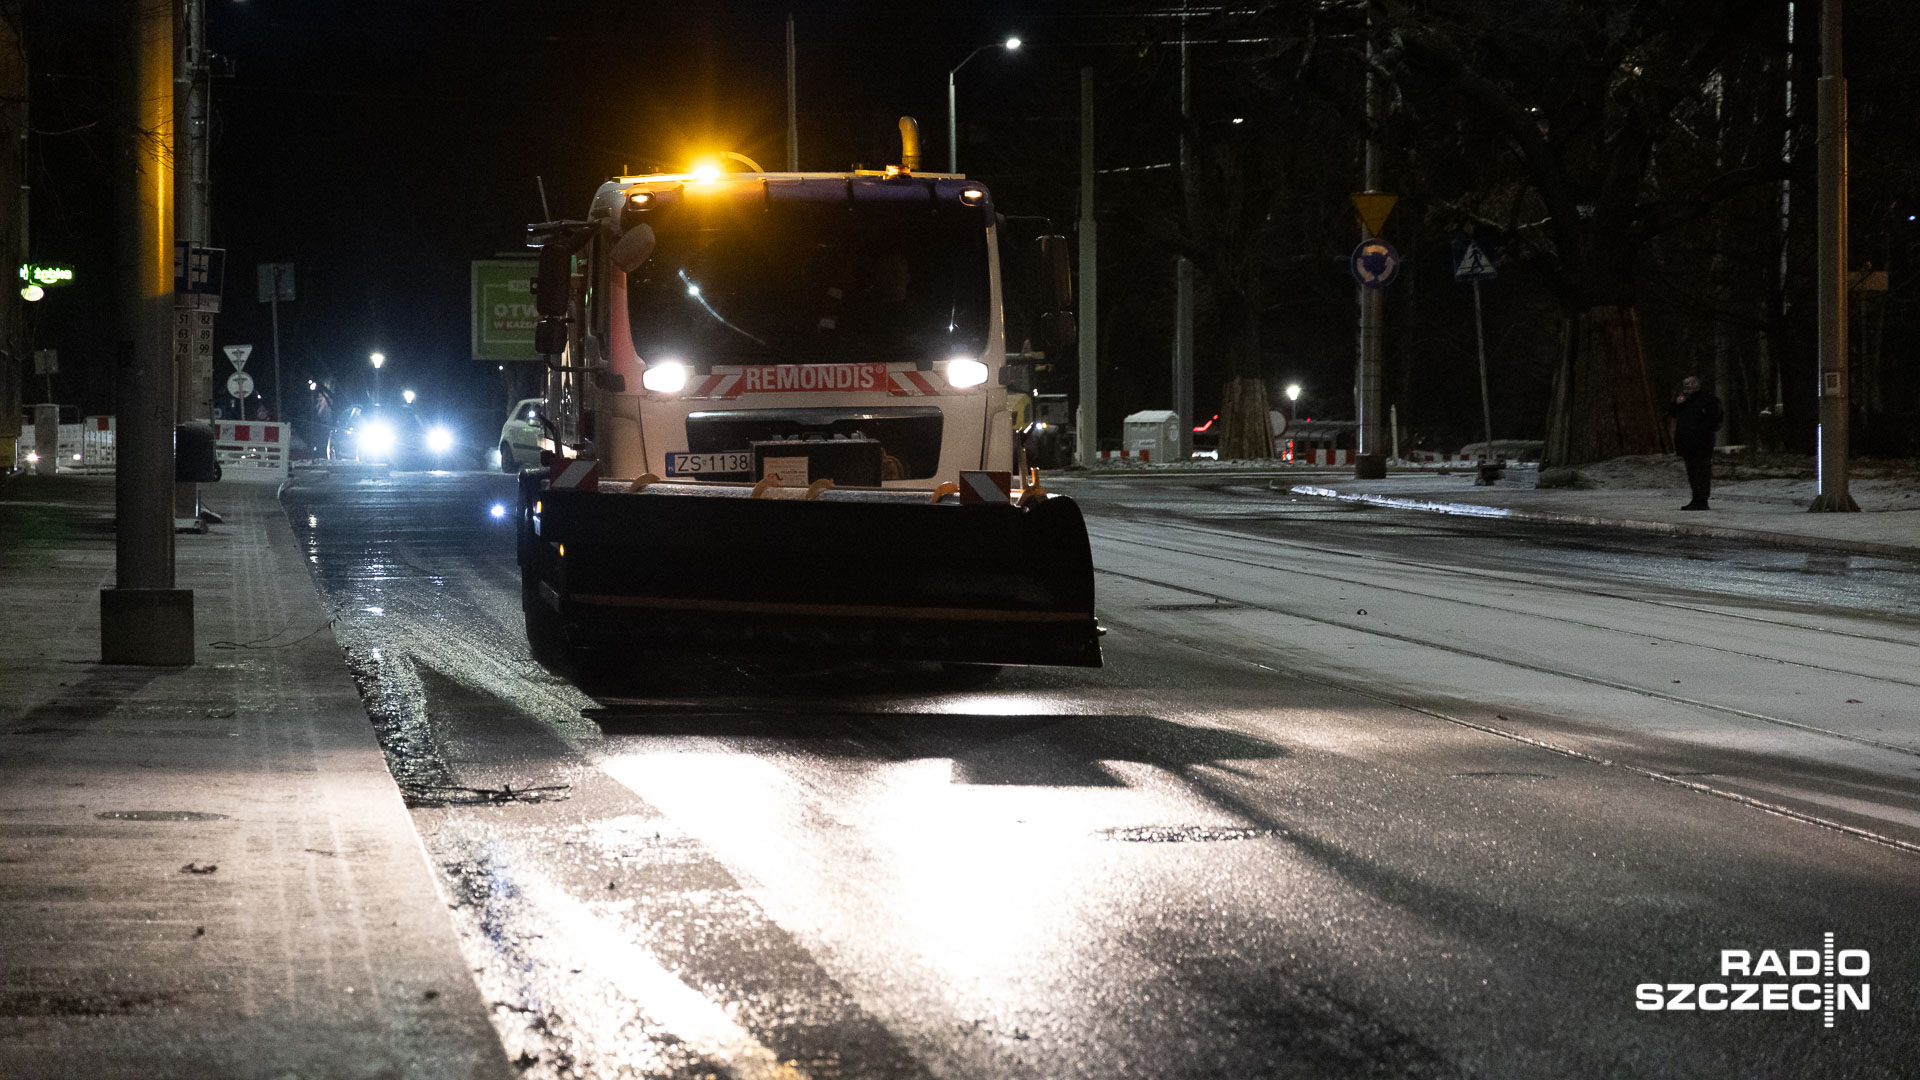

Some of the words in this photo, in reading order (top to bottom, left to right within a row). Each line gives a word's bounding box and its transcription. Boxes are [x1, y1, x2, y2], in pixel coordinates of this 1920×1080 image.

[179, 314, 188, 324] 51
[201, 315, 210, 325] 82
[178, 329, 188, 339] 63
[200, 330, 210, 339] 89
[178, 343, 188, 353] 78
[200, 344, 209, 354] 99
[677, 455, 702, 472] ZS
[709, 454, 753, 471] 1138
